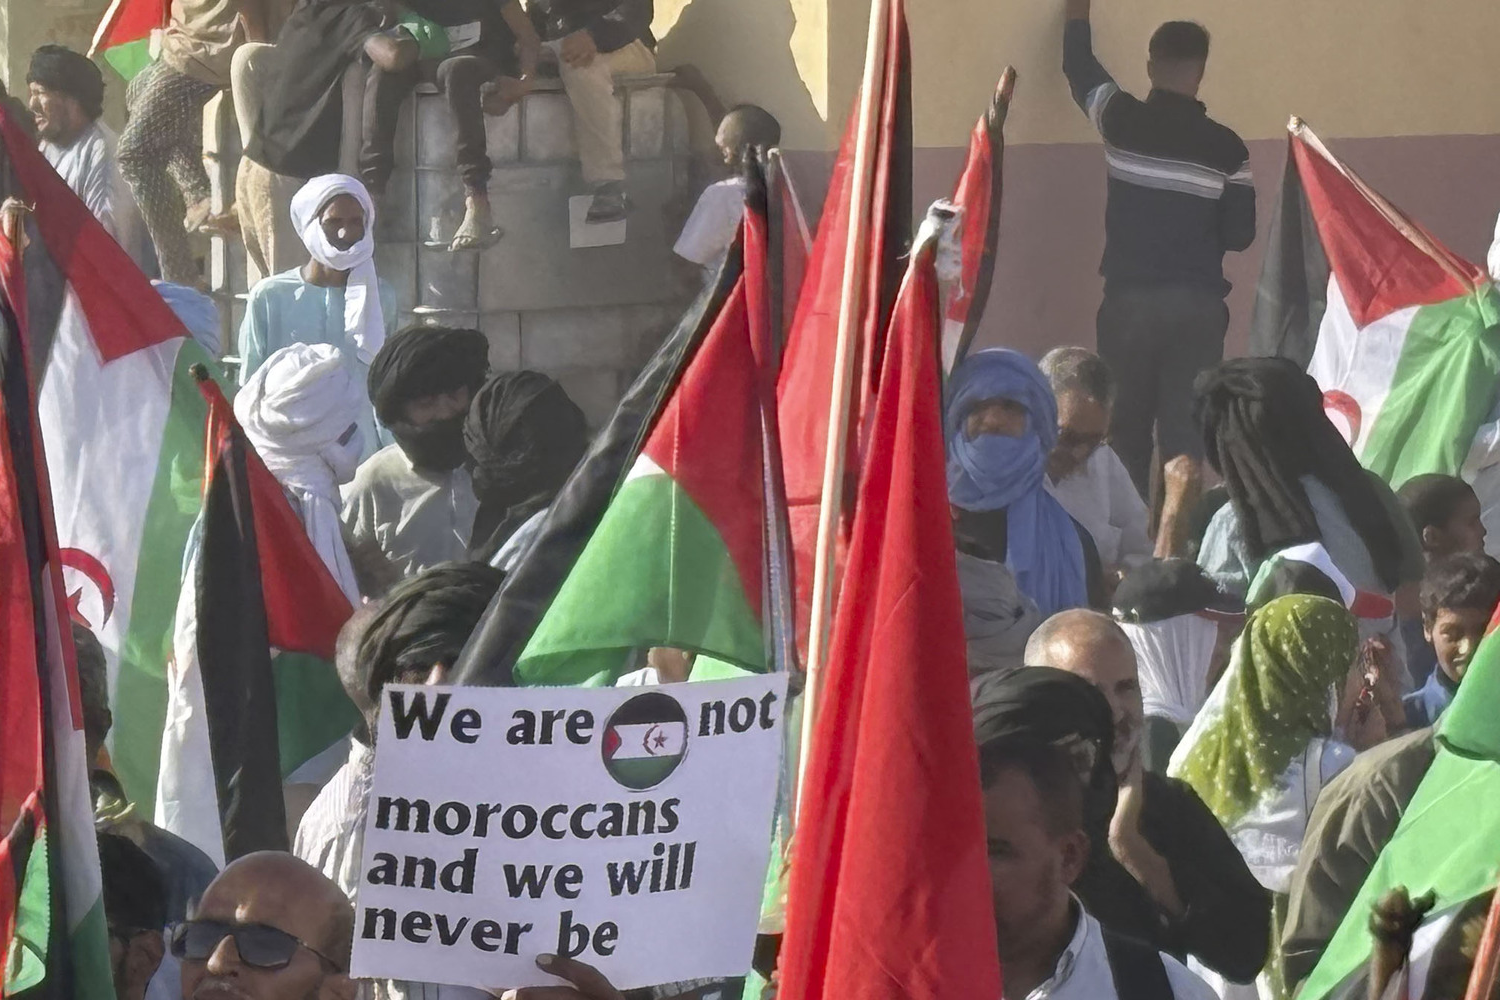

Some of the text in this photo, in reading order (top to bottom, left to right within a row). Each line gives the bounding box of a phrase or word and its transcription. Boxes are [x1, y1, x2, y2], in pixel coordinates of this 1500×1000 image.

[389, 690, 776, 745] We are not
[375, 797, 680, 839] moroccans
[367, 841, 696, 899] and we will
[362, 907, 618, 957] never be
